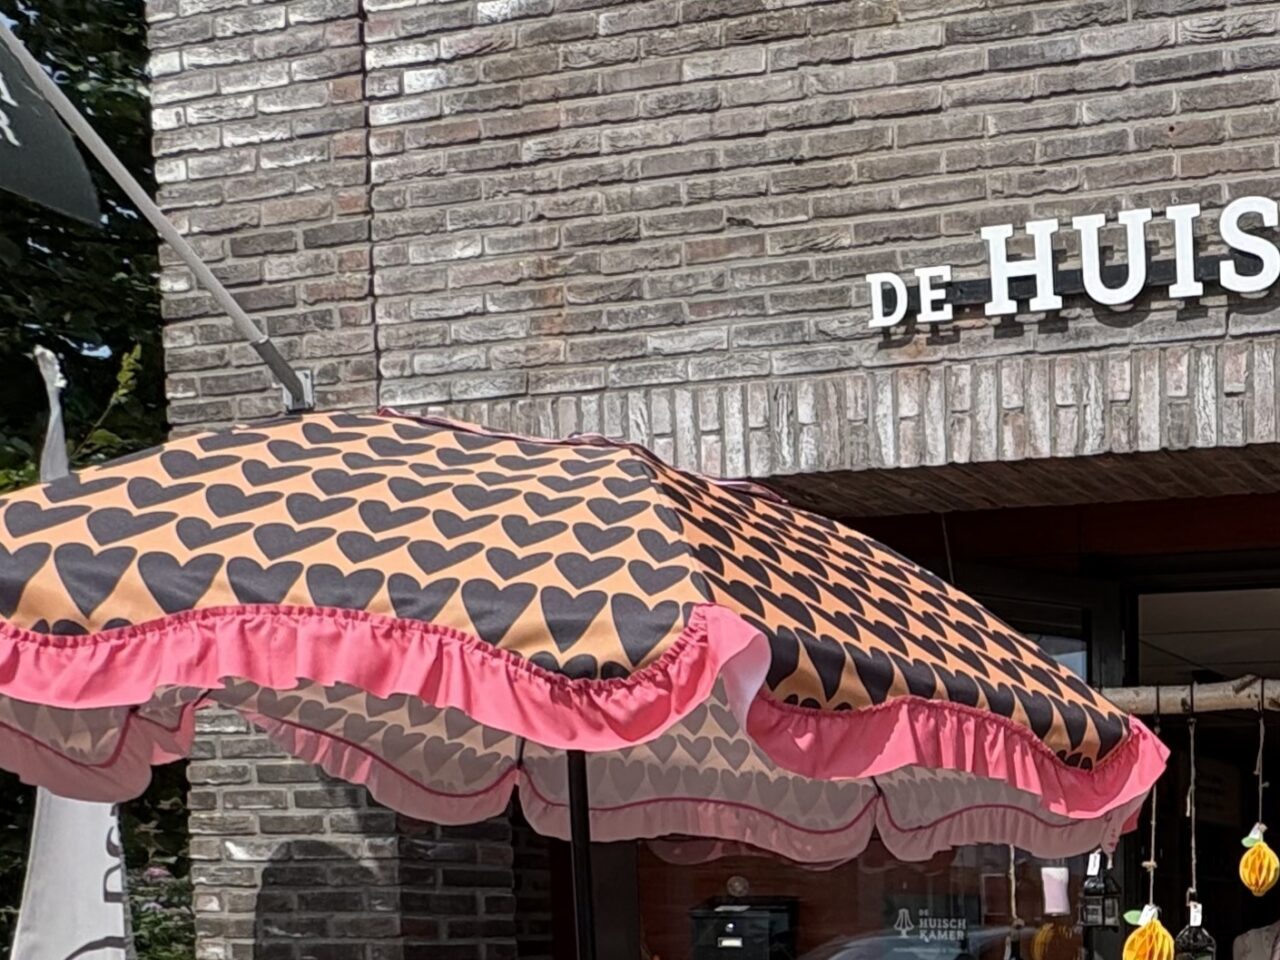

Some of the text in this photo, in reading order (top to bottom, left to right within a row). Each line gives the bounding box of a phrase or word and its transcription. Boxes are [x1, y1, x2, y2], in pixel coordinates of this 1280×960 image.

[866, 264, 954, 328] DE
[918, 917, 967, 930] HUISCH
[919, 929, 965, 942] KAMER
